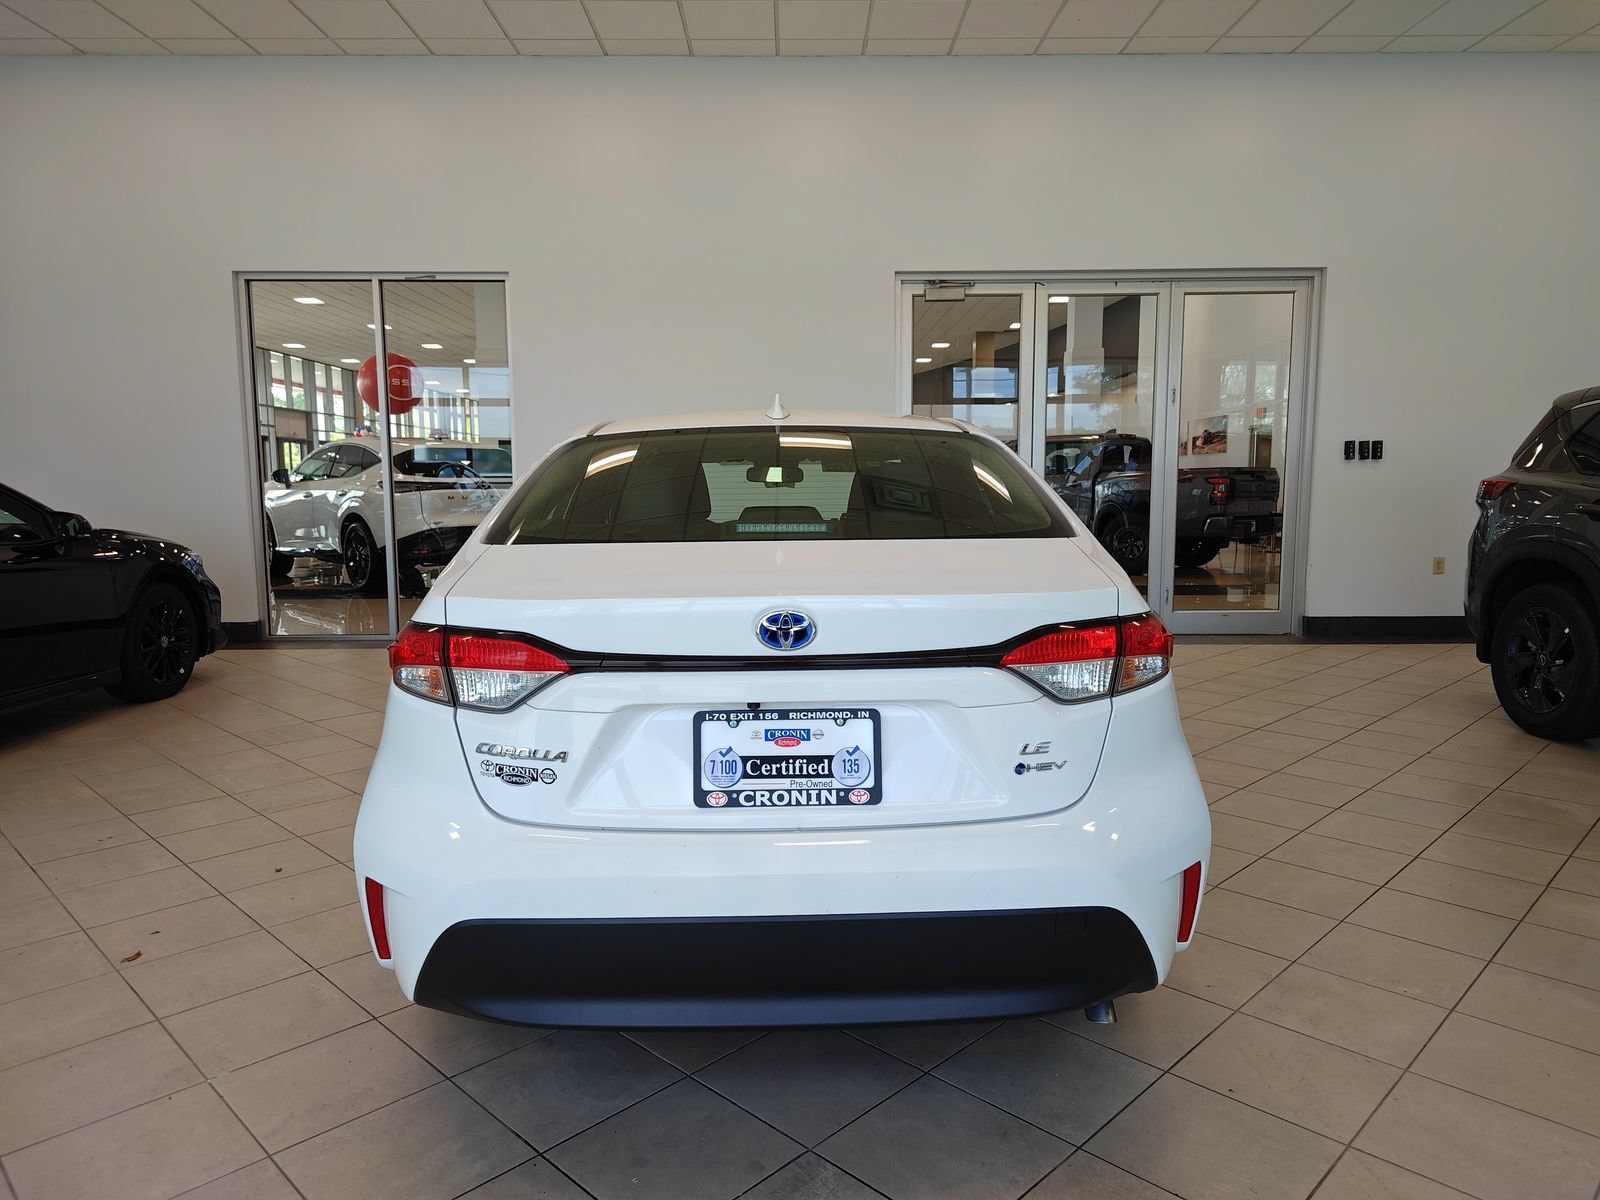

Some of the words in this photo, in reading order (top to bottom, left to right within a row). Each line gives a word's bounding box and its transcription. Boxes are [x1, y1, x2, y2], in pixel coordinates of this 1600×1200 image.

[758, 712, 779, 720] 156
[789, 711, 854, 719] RICHMOND,
[767, 729, 808, 740] CRONIN
[475, 742, 569, 763] COROLLA
[1019, 741, 1052, 755] LE
[496, 764, 538, 780] CRONIN
[746, 758, 830, 776] Certified
[842, 758, 860, 774] 135
[1026, 760, 1067, 772] HEV
[790, 780, 833, 788] Pre-Owned
[738, 789, 837, 806] CRONIN
